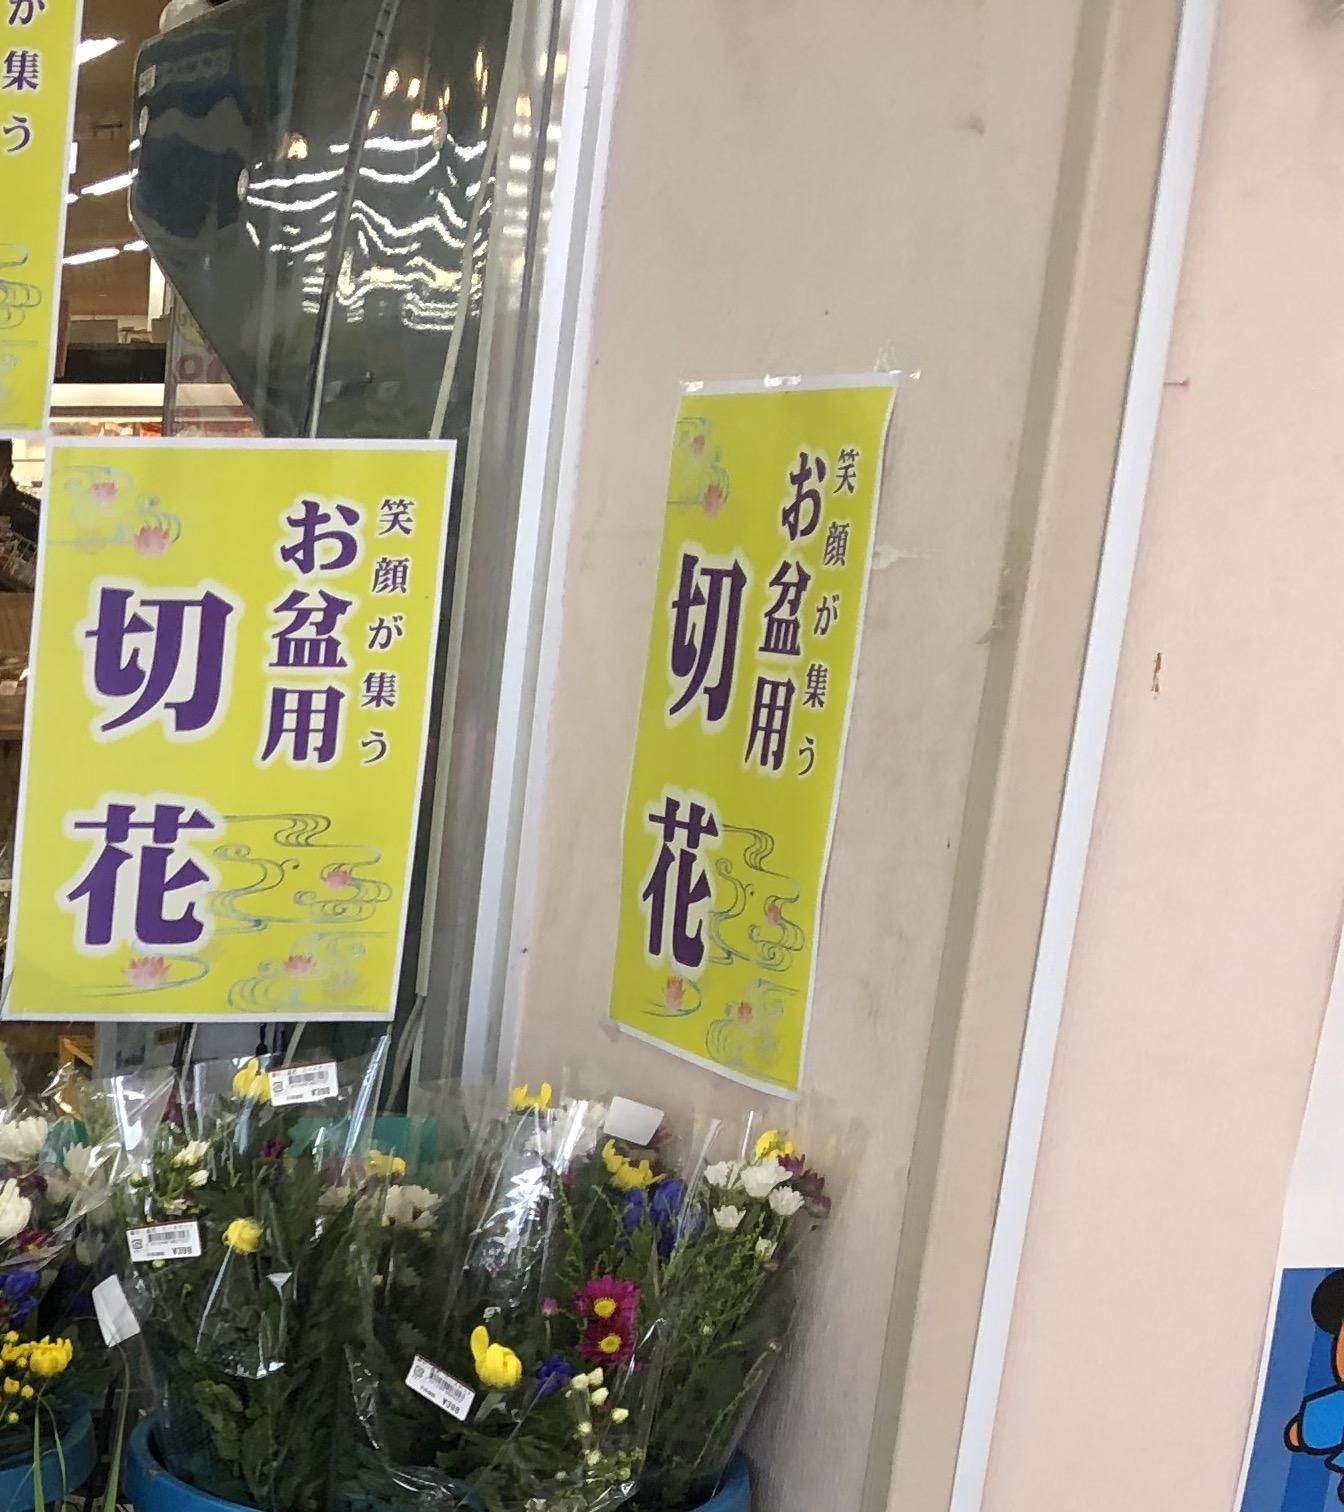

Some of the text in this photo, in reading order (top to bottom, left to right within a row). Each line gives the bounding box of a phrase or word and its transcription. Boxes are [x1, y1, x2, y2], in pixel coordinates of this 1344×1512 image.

[67, 587, 235, 946] 切花
[261, 499, 361, 763] お盆用
[360, 498, 415, 766] 笑顔が集う
[642, 553, 748, 969] 切花
[744, 451, 827, 771] お盆用
[799, 447, 860, 776] 笑顔が集う
